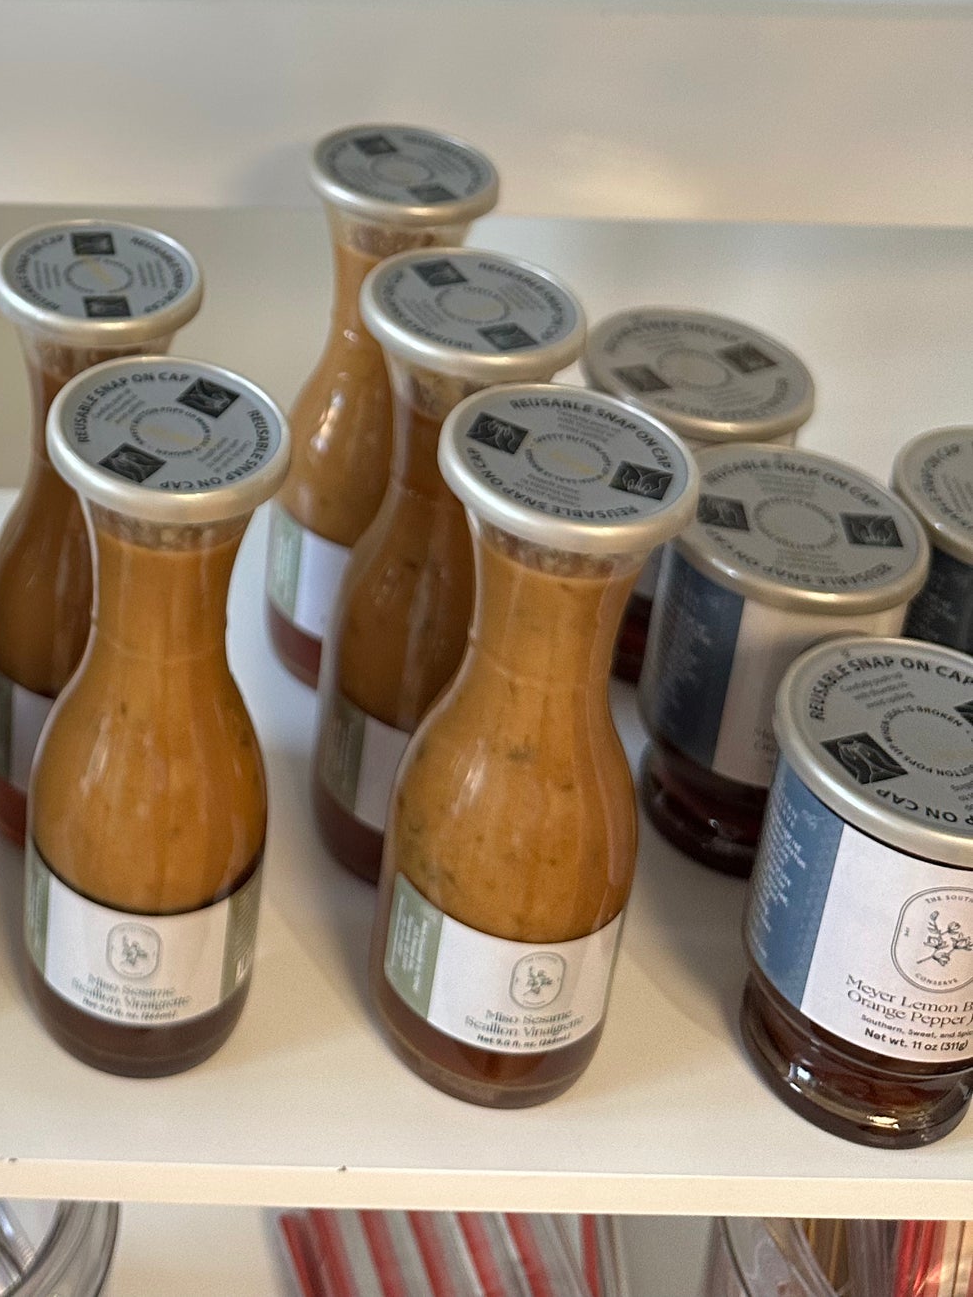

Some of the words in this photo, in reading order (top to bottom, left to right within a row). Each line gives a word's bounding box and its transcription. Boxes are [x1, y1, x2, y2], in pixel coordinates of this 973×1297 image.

[809, 664, 850, 721] REUSABLE
[848, 655, 894, 671] SNAP
[900, 657, 930, 672] ON
[916, 705, 963, 728] BROKEN
[877, 789, 919, 811] CAP
[926, 806, 958, 823] ON
[846, 974, 896, 1003] Meyer
[901, 996, 958, 1013] Lemon
[847, 989, 906, 1020] Orange
[910, 1011, 967, 1029] Pepper
[864, 1027, 886, 1042] Net
[889, 1036, 908, 1048] wt.
[912, 1040, 922, 1050] 11
[924, 1043, 937, 1051] oz
[956, 1030, 973, 1040] Spic
